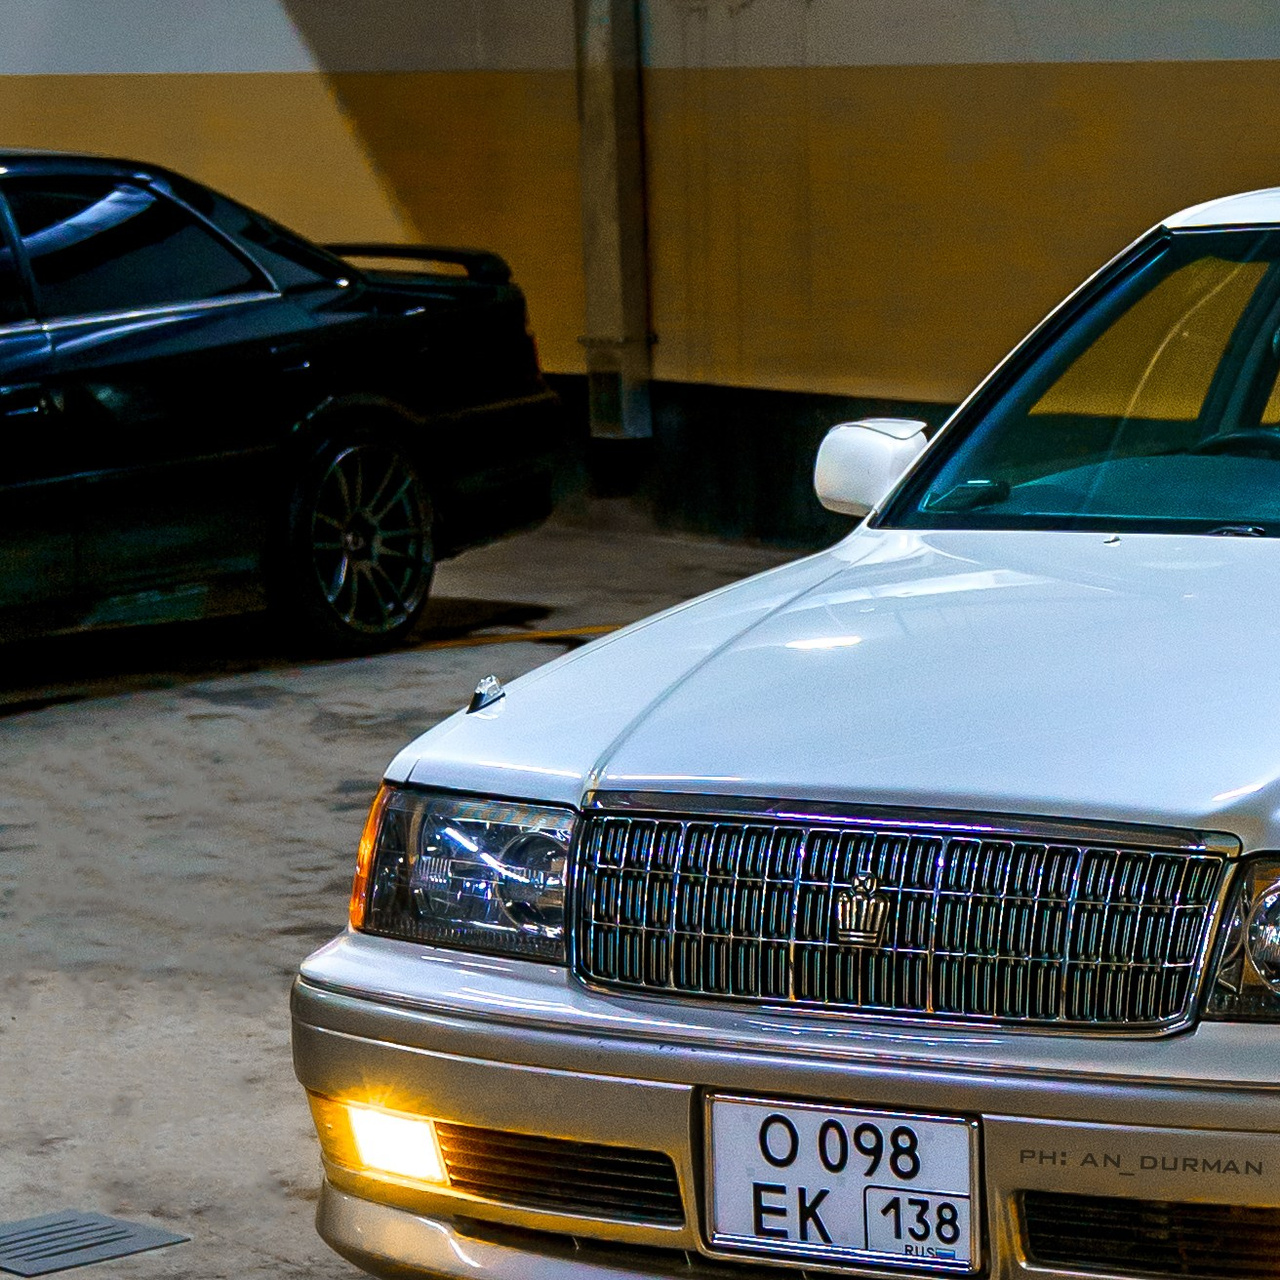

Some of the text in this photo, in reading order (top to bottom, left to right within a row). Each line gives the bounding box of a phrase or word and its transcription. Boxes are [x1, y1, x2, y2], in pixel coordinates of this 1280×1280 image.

[818, 1118, 921, 1180] 098
[880, 1196, 960, 1245] 138
[904, 1244, 936, 1257] RUS
